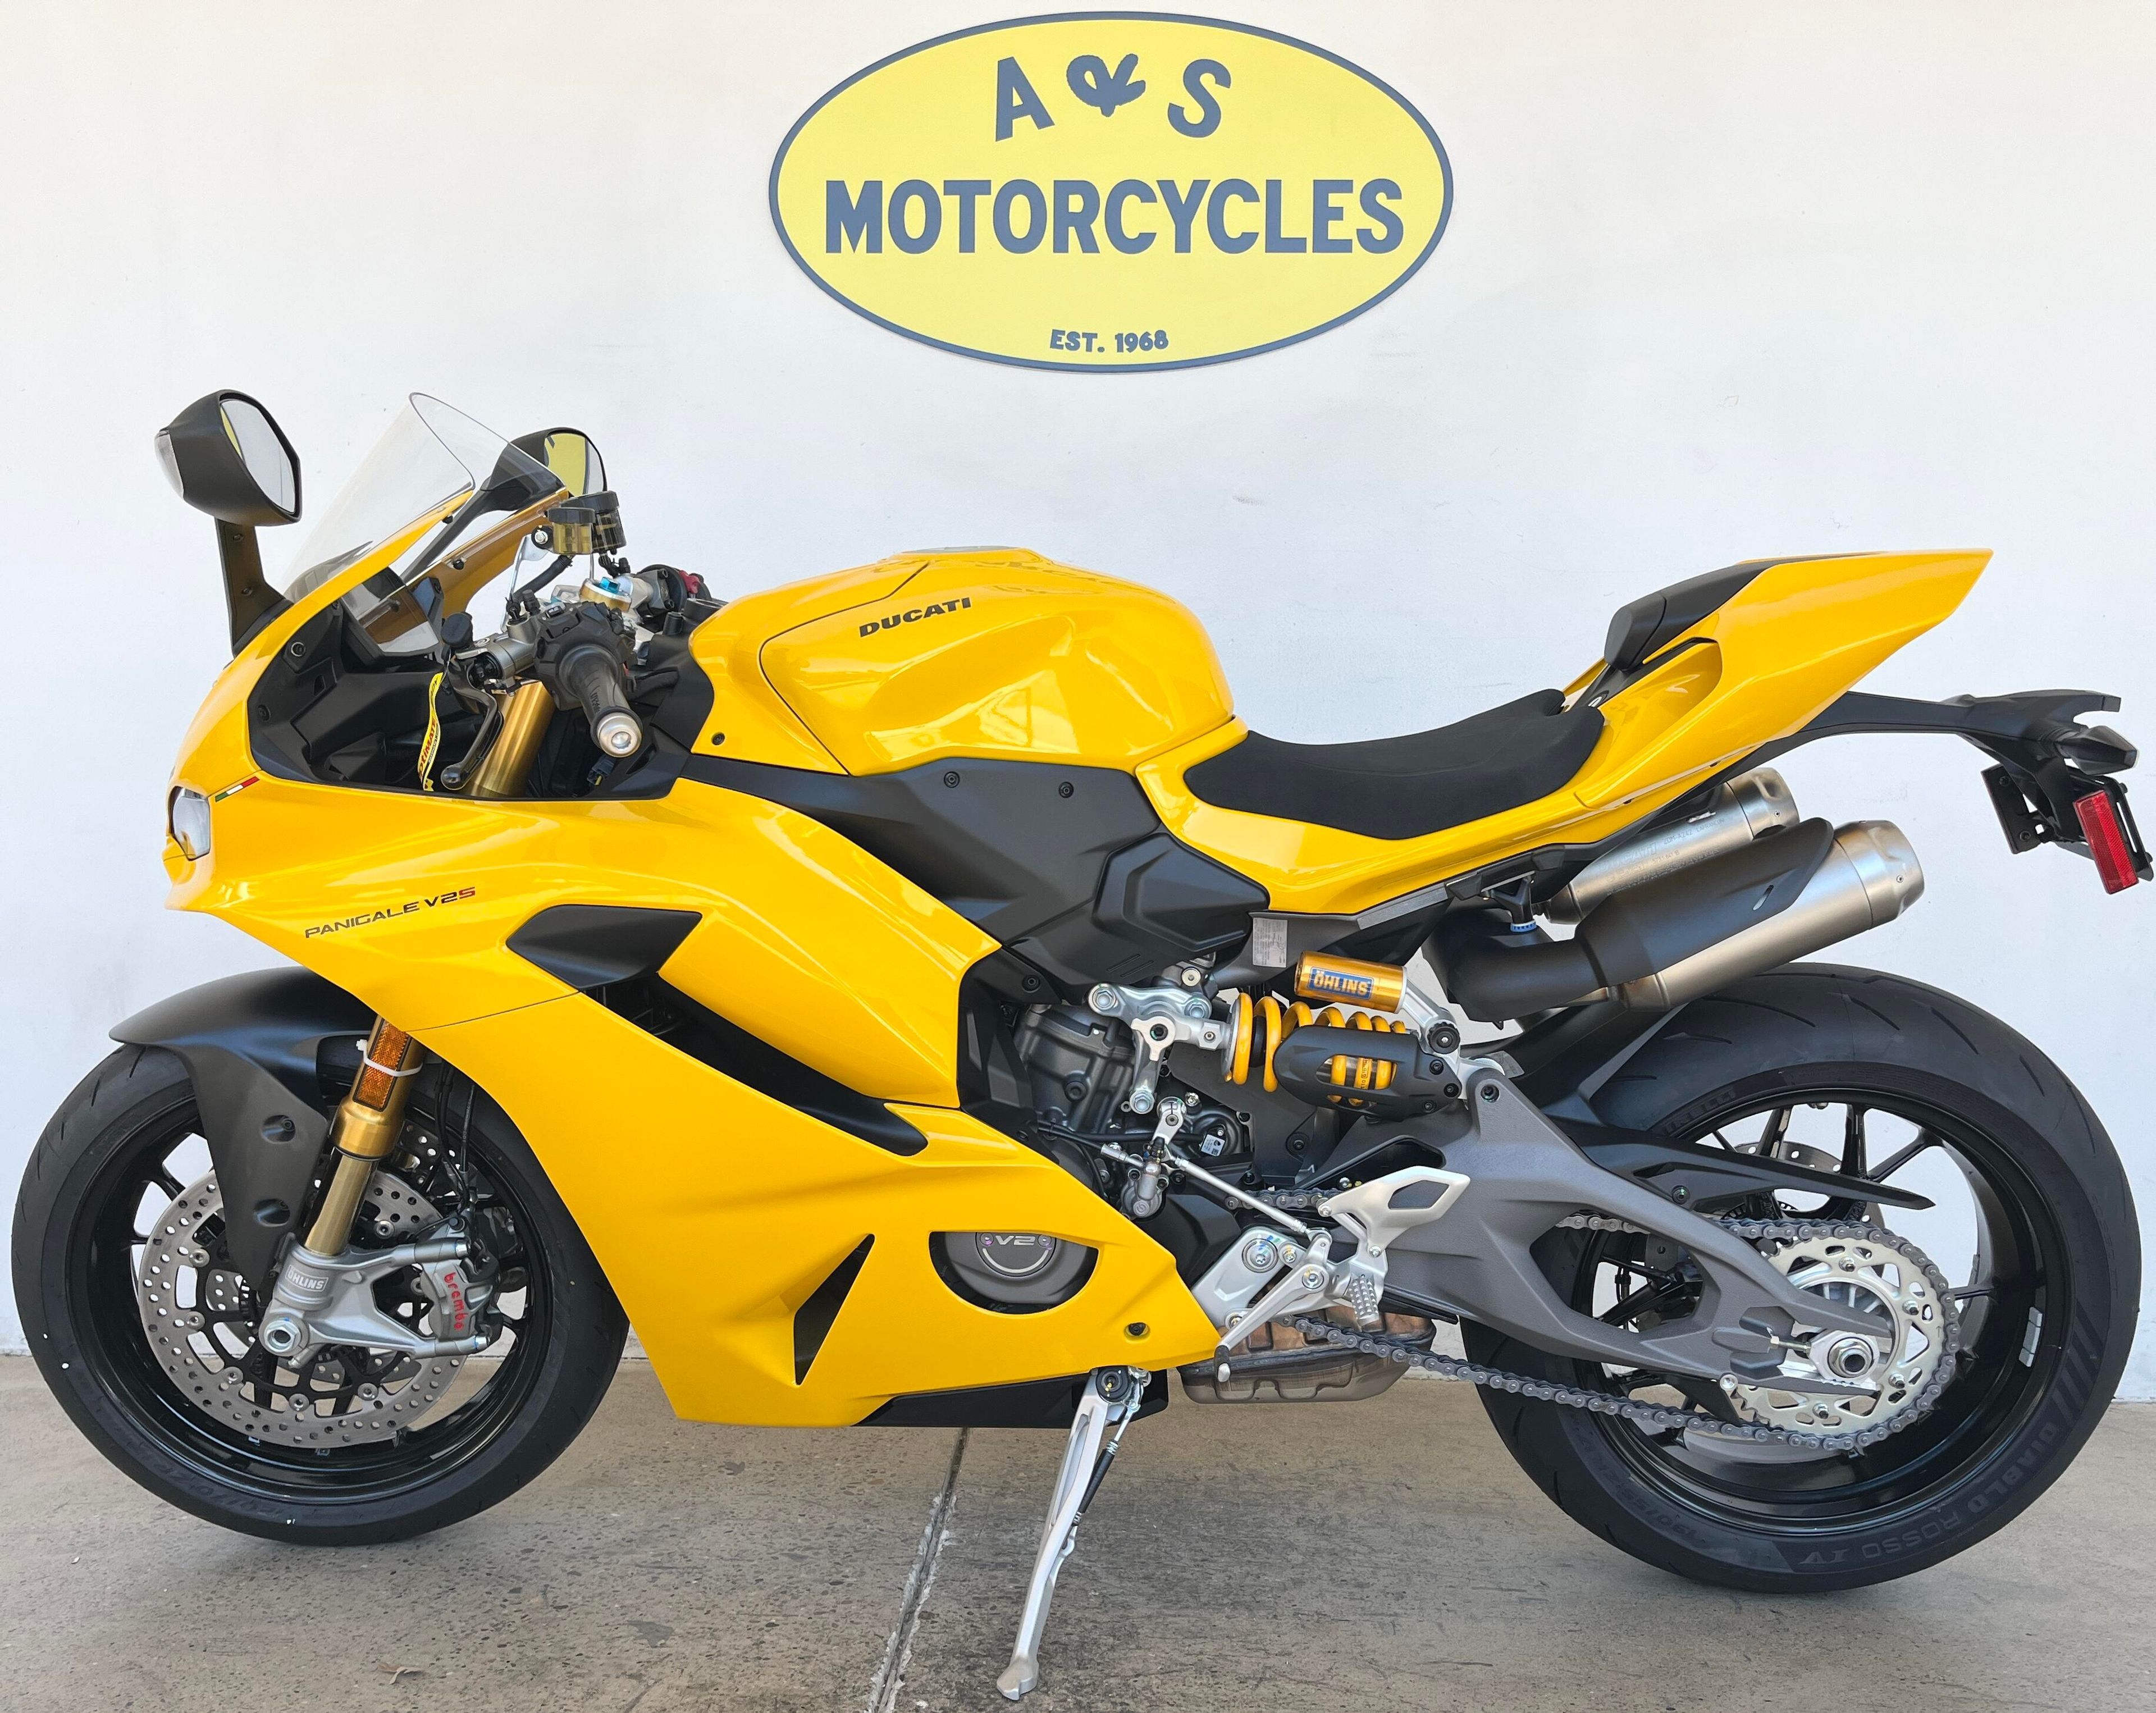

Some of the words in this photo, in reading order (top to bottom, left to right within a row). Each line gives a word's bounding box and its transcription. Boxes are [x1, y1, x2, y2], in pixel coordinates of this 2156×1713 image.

[995, 56, 1055, 141] A
[1167, 58, 1231, 138] S
[825, 178, 1404, 254] MOTORCYCLES
[1050, 329, 1105, 353] EST.
[1114, 330, 1169, 353] 1968
[859, 597, 971, 638] DUCATI
[305, 901, 421, 938] PANIGALE
[424, 887, 476, 907] V2S
[1314, 970, 1369, 996] ÖHLINS
[995, 1235, 1036, 1246] V2
[287, 1267, 325, 1290] ÖHLINS
[444, 1272, 469, 1331] brembo
[1967, 1421, 2057, 1514] DIABLO
[1798, 1547, 1852, 1564] IV
[1861, 1510, 1962, 1559] ROSSO
